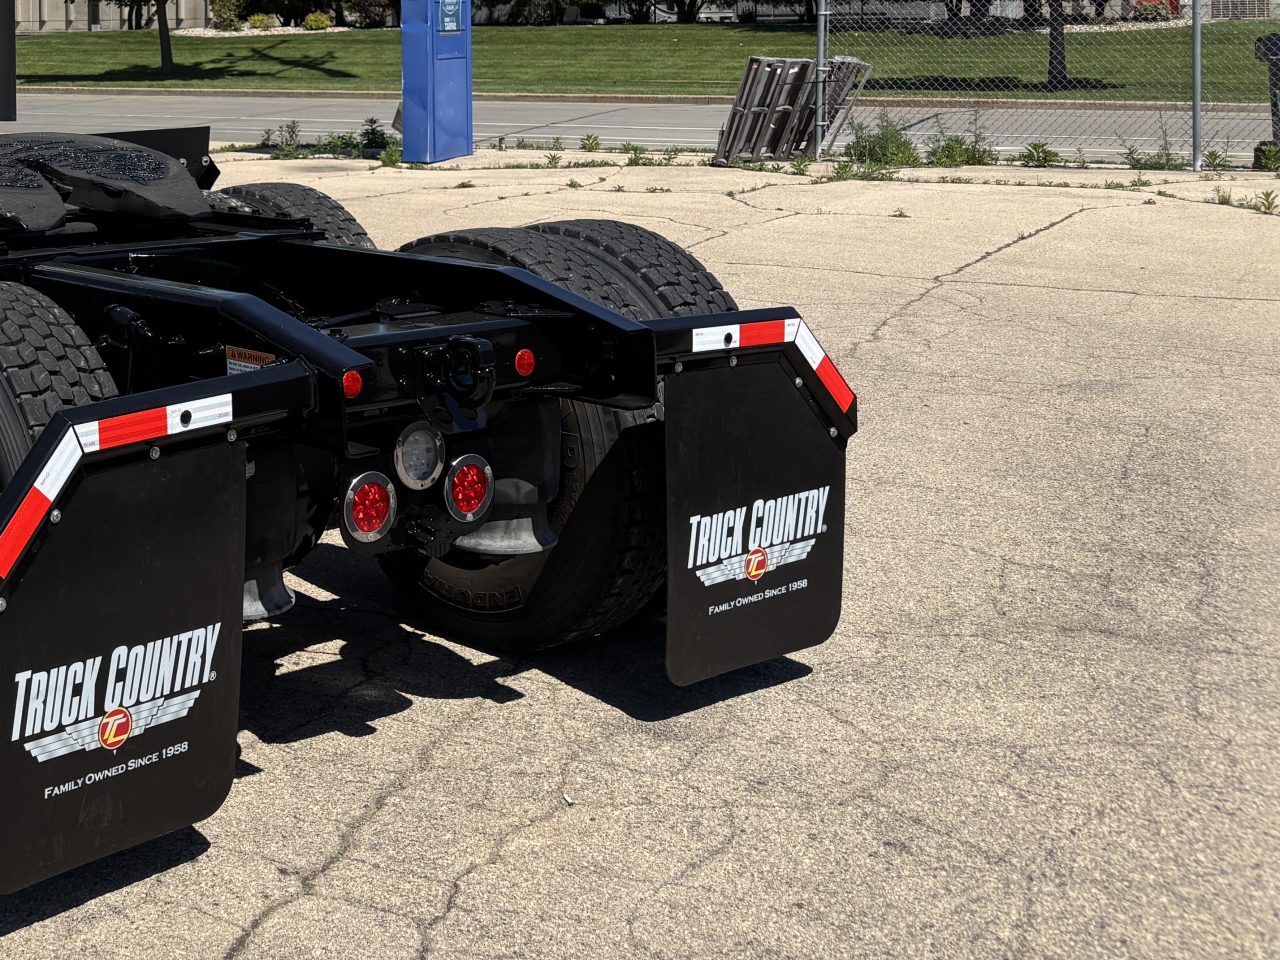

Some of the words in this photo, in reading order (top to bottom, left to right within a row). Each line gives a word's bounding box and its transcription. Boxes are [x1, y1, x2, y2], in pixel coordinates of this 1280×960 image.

[237, 350, 270, 366] WARNING
[688, 506, 747, 570] TRUCK
[748, 485, 830, 551] COUNTRY
[708, 600, 735, 616] FAMILY
[736, 592, 764, 607] OWNED
[764, 585, 787, 598] SINCE
[788, 579, 808, 592] 1958
[11, 656, 102, 741] TRUCK
[104, 622, 221, 712] COUNTRY
[44, 777, 84, 799] FAMILY
[85, 764, 127, 785] OWNED
[127, 752, 159, 771] SINCE
[161, 741, 189, 759] 1958
